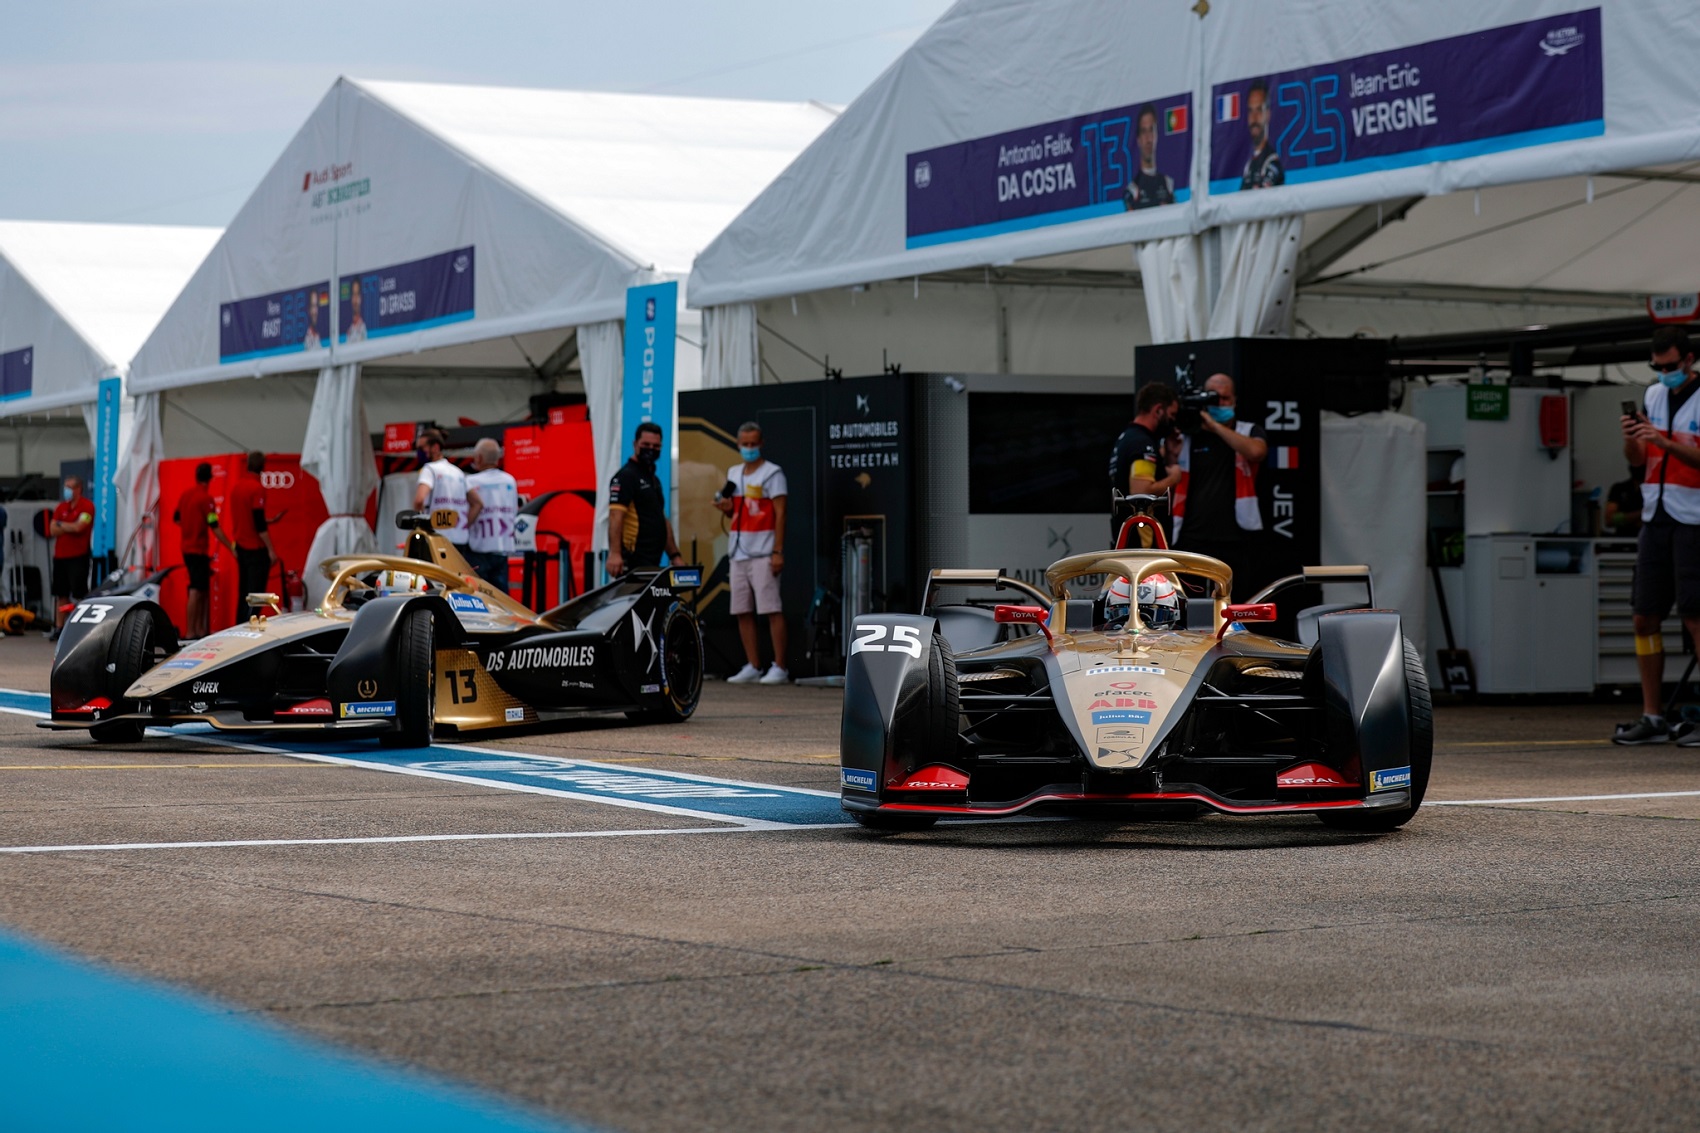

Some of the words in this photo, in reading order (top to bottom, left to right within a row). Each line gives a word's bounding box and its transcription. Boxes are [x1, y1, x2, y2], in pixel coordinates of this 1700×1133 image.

[1350, 62, 1421, 98] Jean-Eric
[1351, 93, 1439, 138] VERGNE
[998, 139, 1043, 168] Antonio
[1043, 133, 1074, 158] Felix
[998, 172, 1021, 202] DA
[1021, 161, 1077, 198] COSTA
[641, 326, 656, 422] POSITI
[1264, 401, 1301, 431] 25
[829, 424, 842, 439] DS
[842, 421, 899, 438] AUTOMOBILES
[829, 452, 899, 468] TECHEETAH
[437, 511, 452, 527] DAC
[1273, 485, 1294, 539] JEV
[650, 585, 672, 597] TOTAL
[70, 603, 114, 624] 13
[1011, 611, 1038, 619] TOTAL
[1232, 610, 1259, 618] TOTAL
[851, 624, 923, 659] 25
[486, 651, 505, 672] DS
[507, 646, 595, 671] AUTOMOBILES
[1089, 667, 1162, 675] MAHLE
[199, 682, 220, 693] AFEX
[444, 669, 478, 705] 13
[356, 706, 393, 714] MICHELIN
[1087, 698, 1158, 710] ABB
[846, 773, 874, 785] MICHELIN
